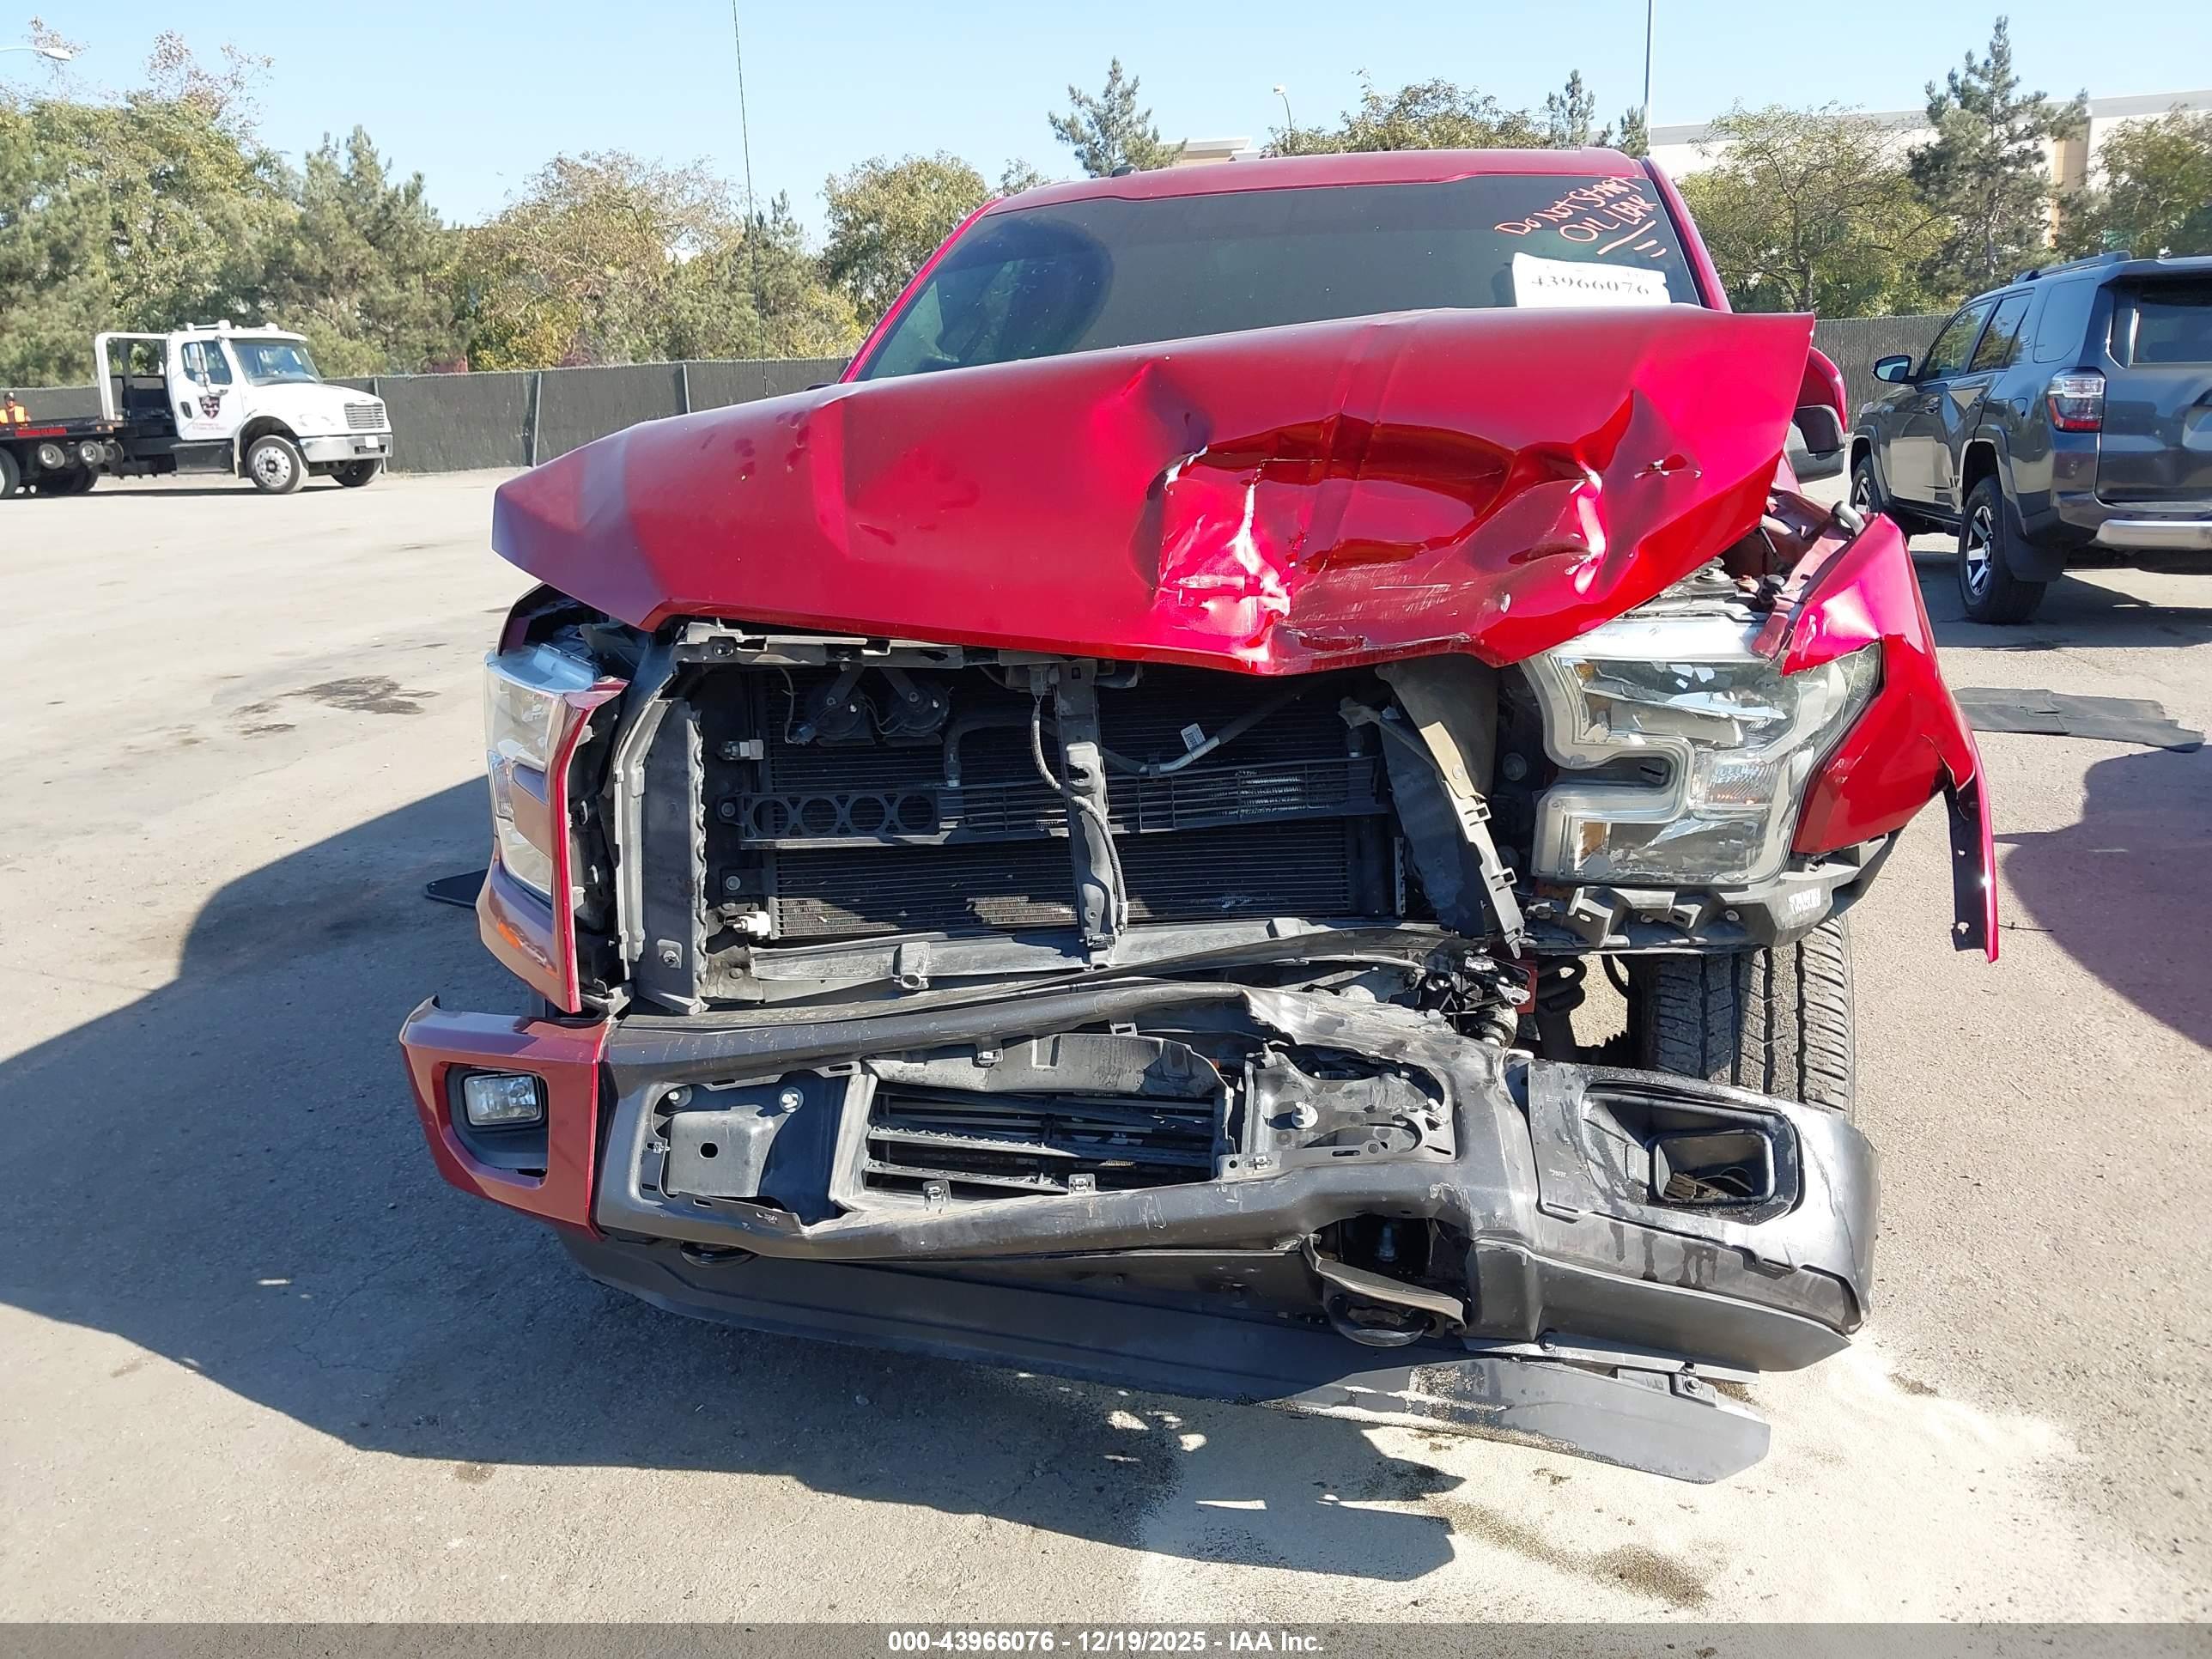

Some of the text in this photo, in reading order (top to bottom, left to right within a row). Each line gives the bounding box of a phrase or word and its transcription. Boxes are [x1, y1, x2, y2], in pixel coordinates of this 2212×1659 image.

[1559, 195, 1659, 242] OIL LEAK
[1532, 276, 1650, 295] 43966076
